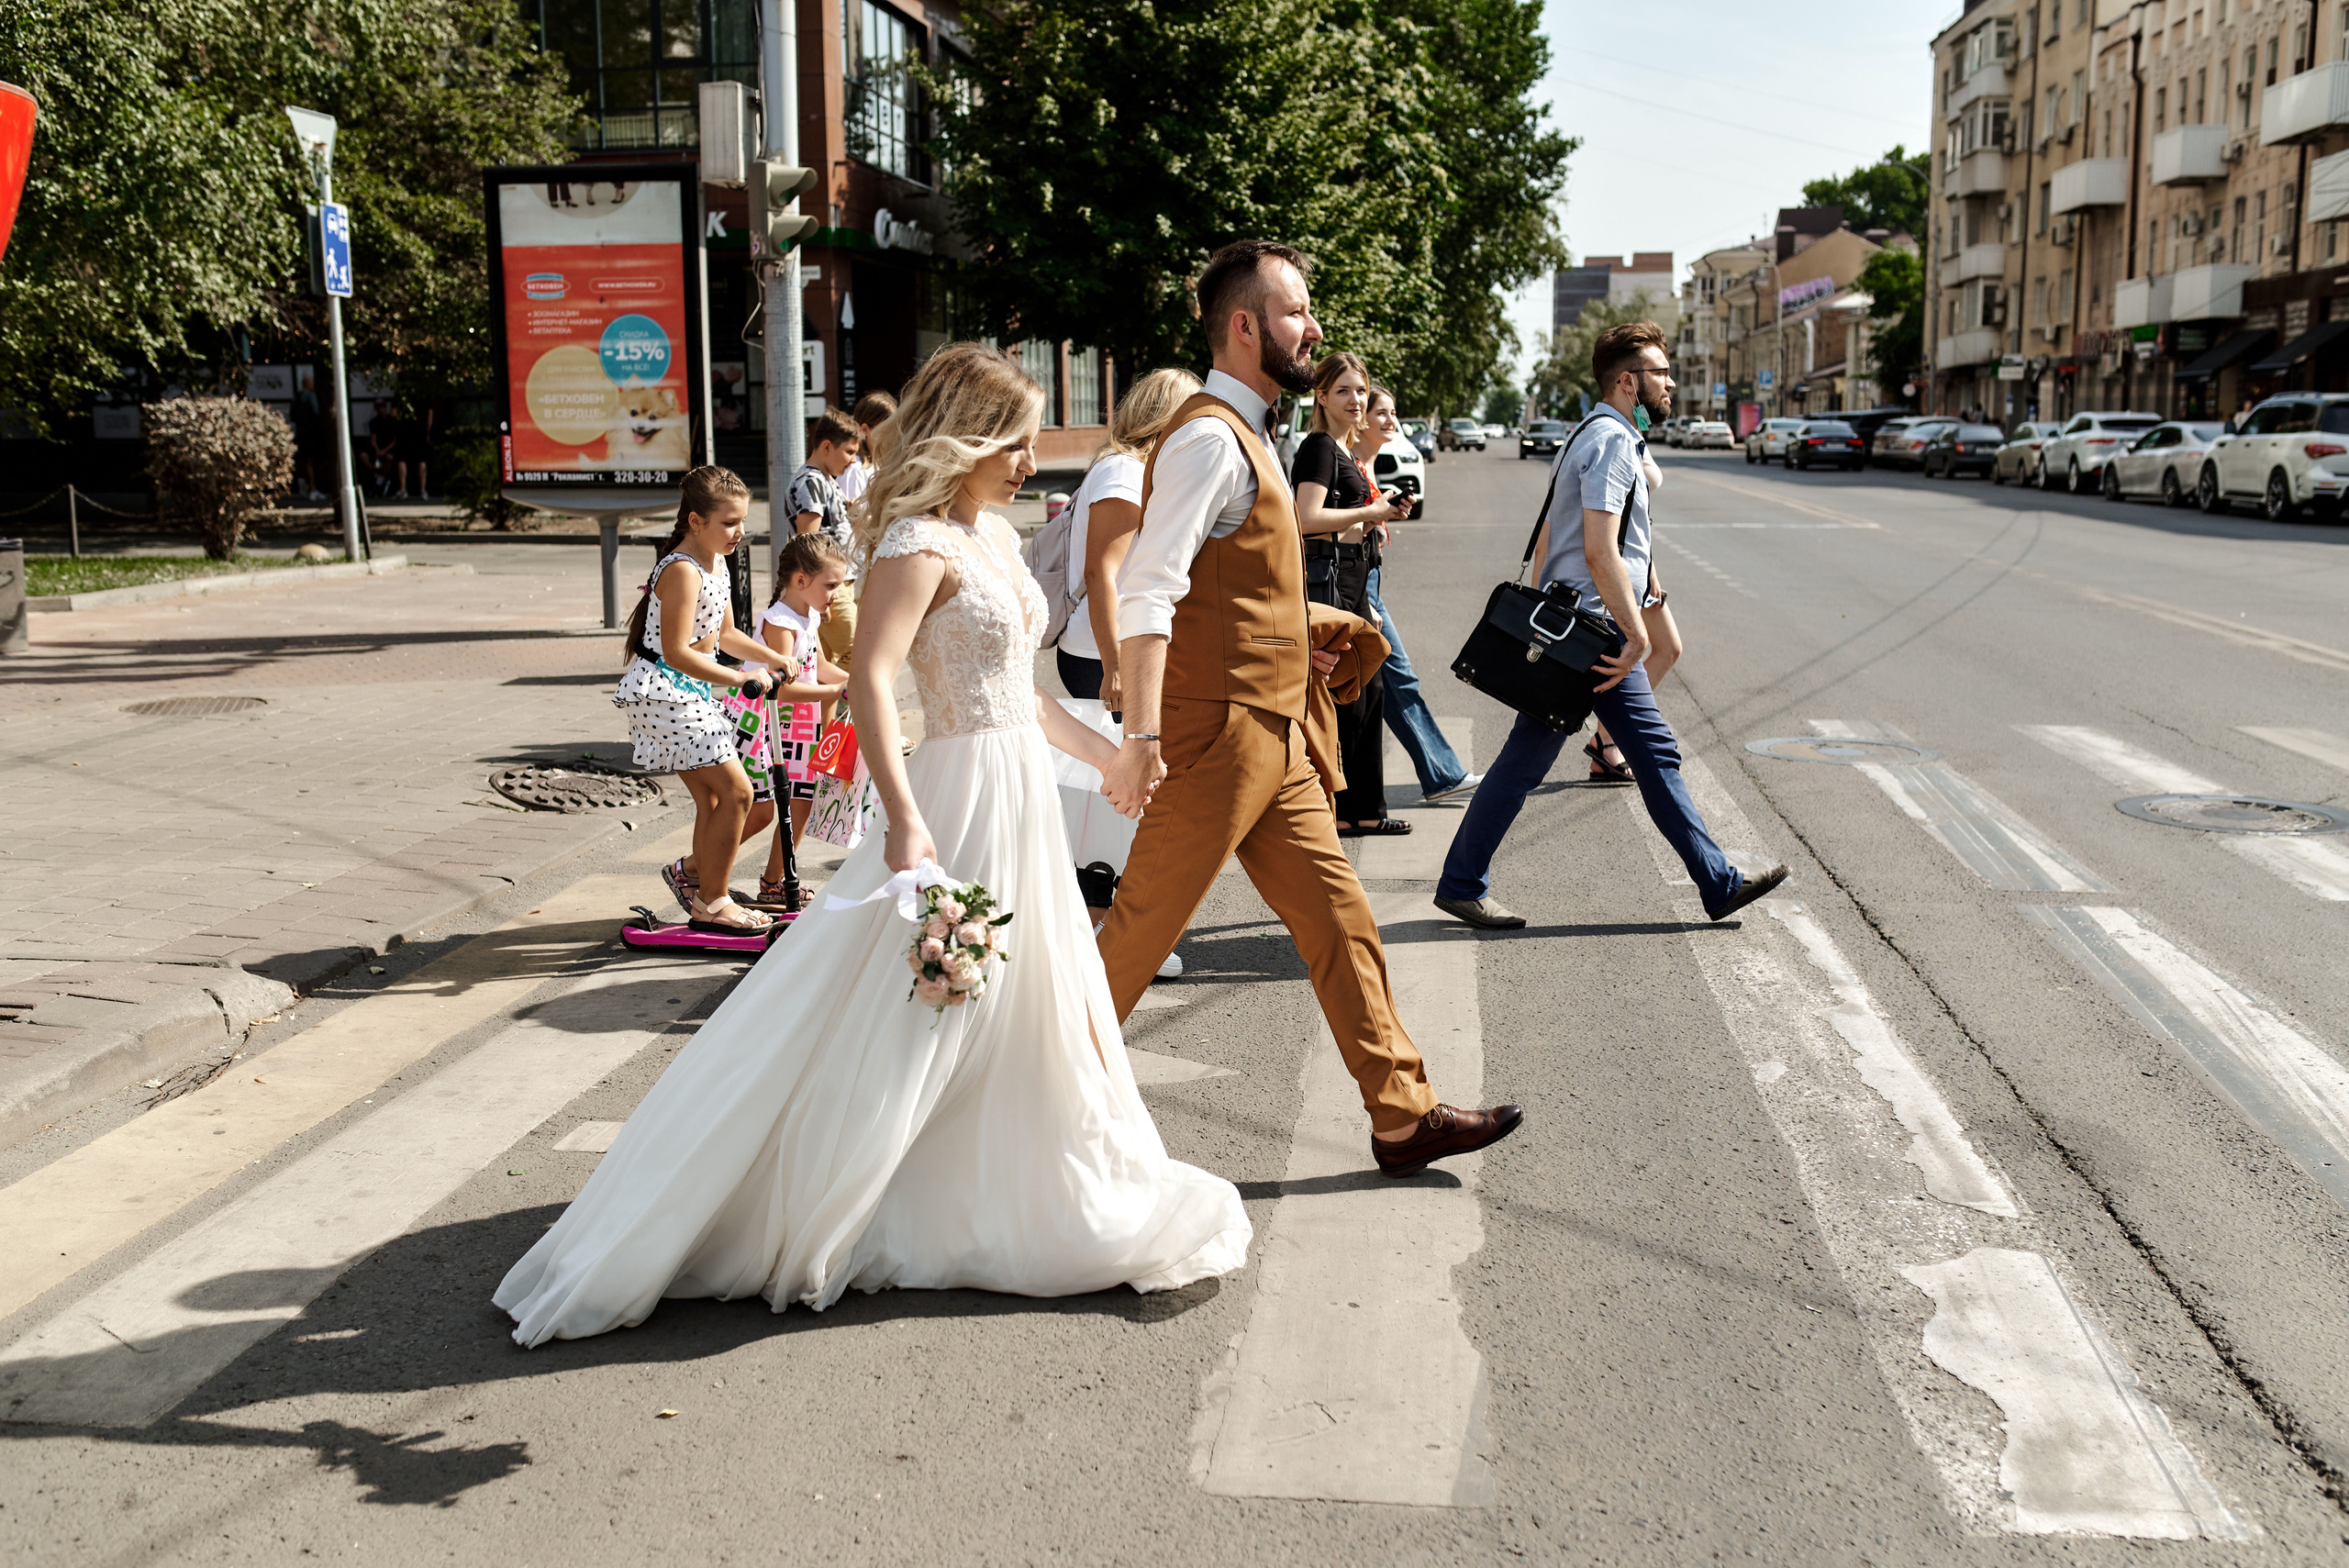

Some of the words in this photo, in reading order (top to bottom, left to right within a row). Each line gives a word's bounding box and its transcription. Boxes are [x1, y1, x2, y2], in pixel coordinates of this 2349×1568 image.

[532, 317, 603, 326] ИНТЕРНЕТ-МАГАЗИН
[533, 326, 572, 335] ВЕТАПТЕКА
[604, 340, 665, 361] -15%
[539, 394, 605, 404] «БЕТХОВЕН
[544, 408, 552, 418] В
[554, 407, 607, 420] СЕРДЦЕ»
[614, 471, 668, 483] 320-30-20
